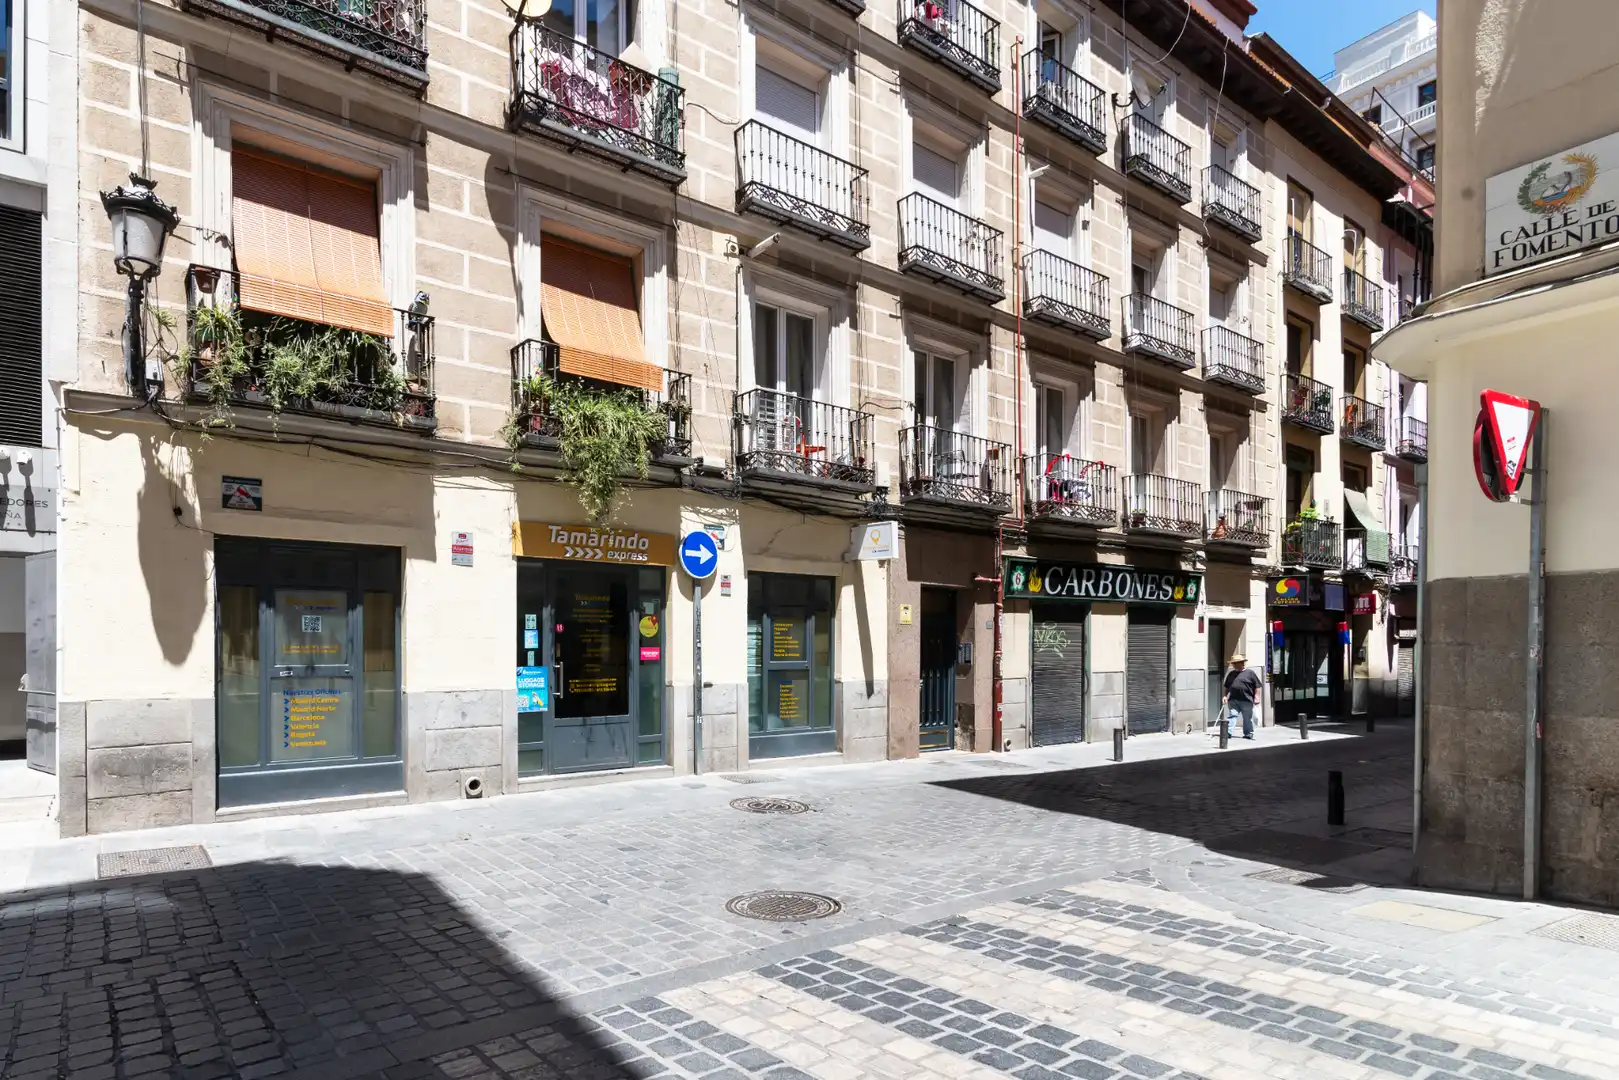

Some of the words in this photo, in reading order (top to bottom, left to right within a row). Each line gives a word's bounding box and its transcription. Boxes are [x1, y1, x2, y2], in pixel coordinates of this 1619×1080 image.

[1500, 209, 1580, 246] CALLE
[1587, 200, 1617, 219] DE
[1492, 214, 1619, 268] FOMENTO
[548, 525, 649, 550] Tamarindo
[607, 550, 648, 561] express
[1015, 572, 1022, 585] 6
[1044, 566, 1175, 600] CARBONES
